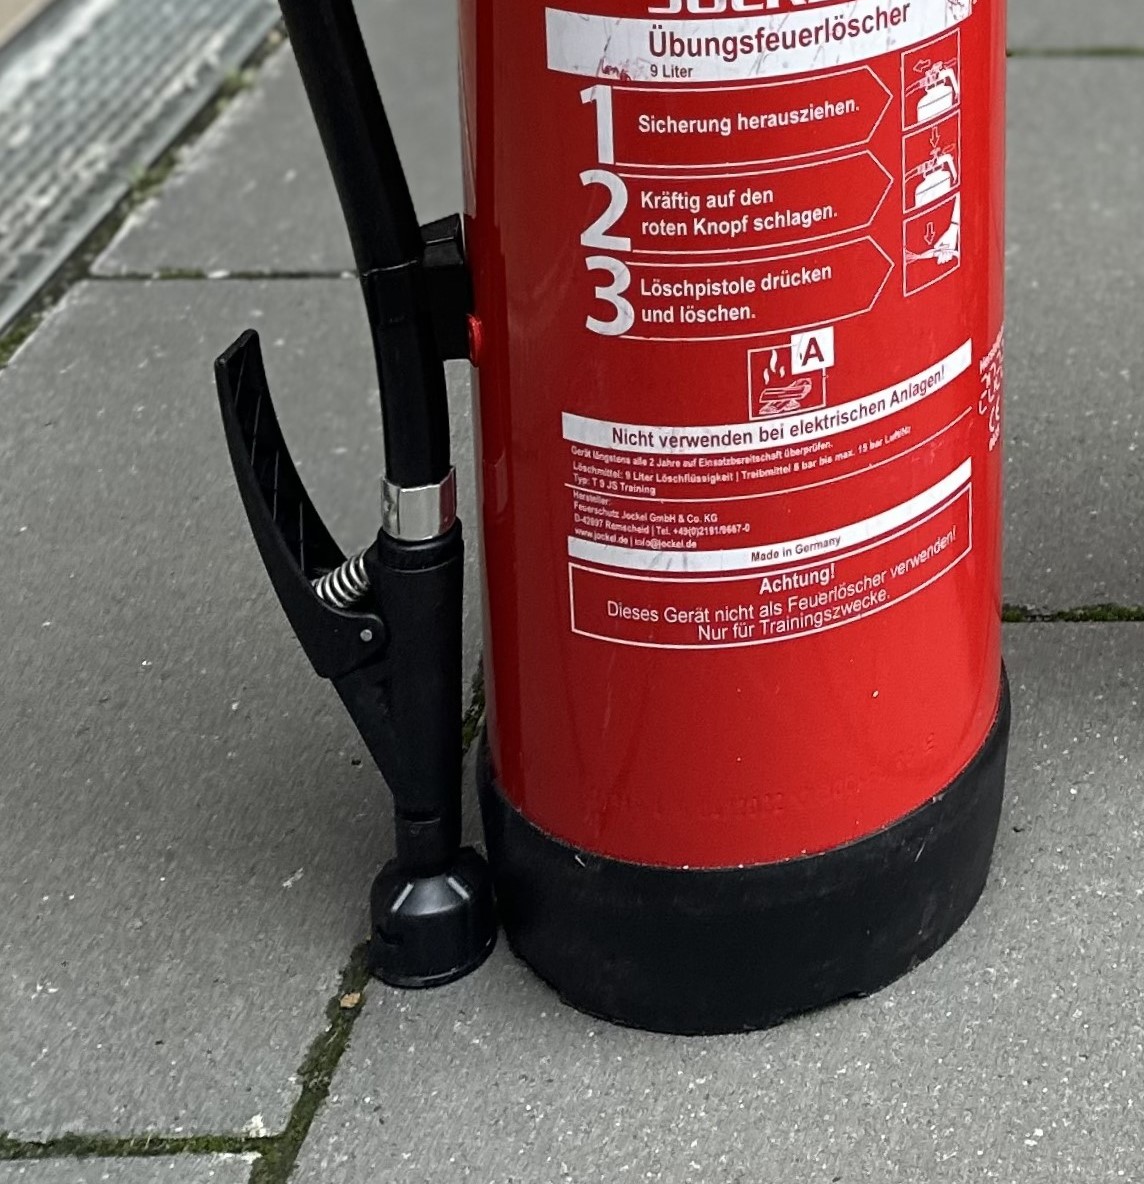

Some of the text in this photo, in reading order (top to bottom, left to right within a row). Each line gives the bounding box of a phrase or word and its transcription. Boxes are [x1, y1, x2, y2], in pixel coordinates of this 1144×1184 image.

[648, 1, 911, 62] Übungsfeuerlöscher
[650, 64, 693, 78] 9 Liter
[579, 84, 615, 165] 1
[638, 97, 860, 137] Sicherung herausziehen.
[579, 169, 632, 251] 2
[640, 188, 774, 213] Kräftig auf den
[641, 203, 838, 238] roten Knopf schlagen.
[585, 255, 635, 337] 3
[640, 264, 832, 301] Löschpistole drücken
[641, 303, 756, 323] und löschen.
[800, 337, 825, 366] A
[612, 367, 946, 448] Nicht verwenden bei elektrischen Anlagen!
[633, 472, 653, 482] Liter
[801, 459, 816, 471] bar
[704, 513, 718, 522] KG
[751, 535, 842, 563] Made in Germany
[607, 526, 957, 623] Dieses Gerät nicht als Feuerlöscher verwenden!
[758, 563, 836, 596] Achtung!
[698, 589, 891, 642] Nur für Trainingszwecke.
